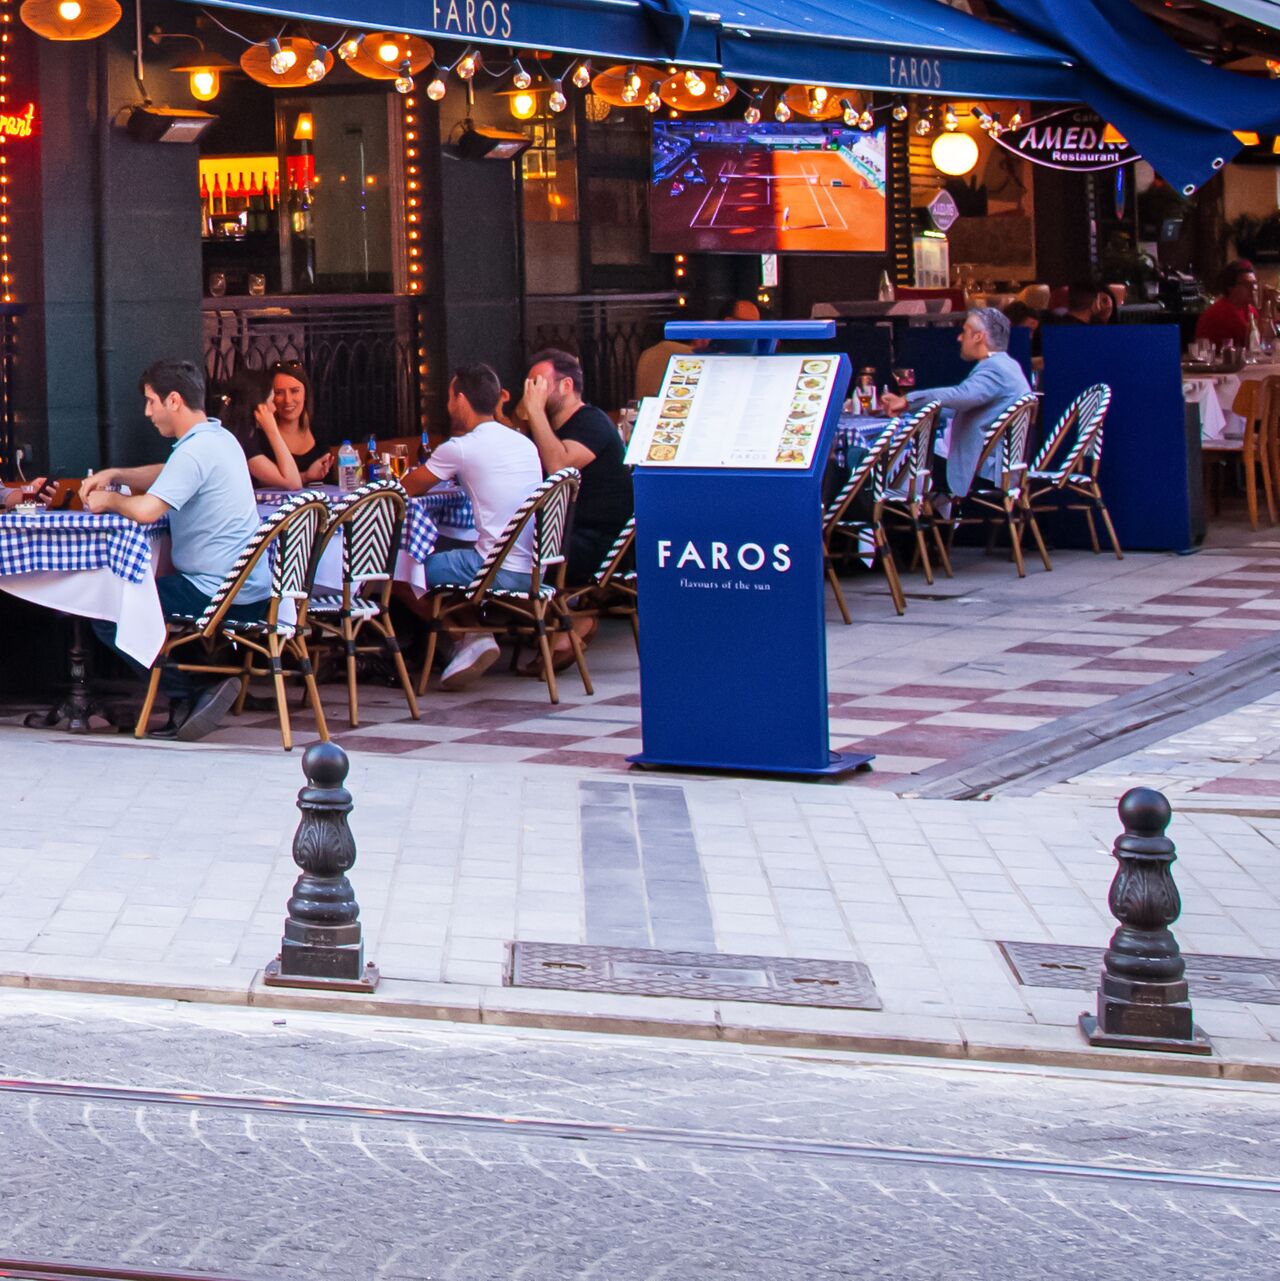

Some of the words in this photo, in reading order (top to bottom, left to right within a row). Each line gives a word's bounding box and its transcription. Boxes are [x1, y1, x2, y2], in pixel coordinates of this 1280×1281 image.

[890, 56, 941, 89] FAROS
[1052, 151, 1119, 161] Restaurant
[657, 540, 792, 572] FAROS
[680, 578, 719, 589] flavours
[722, 579, 733, 589] of
[735, 580, 750, 590] the
[754, 582, 771, 591] sun
